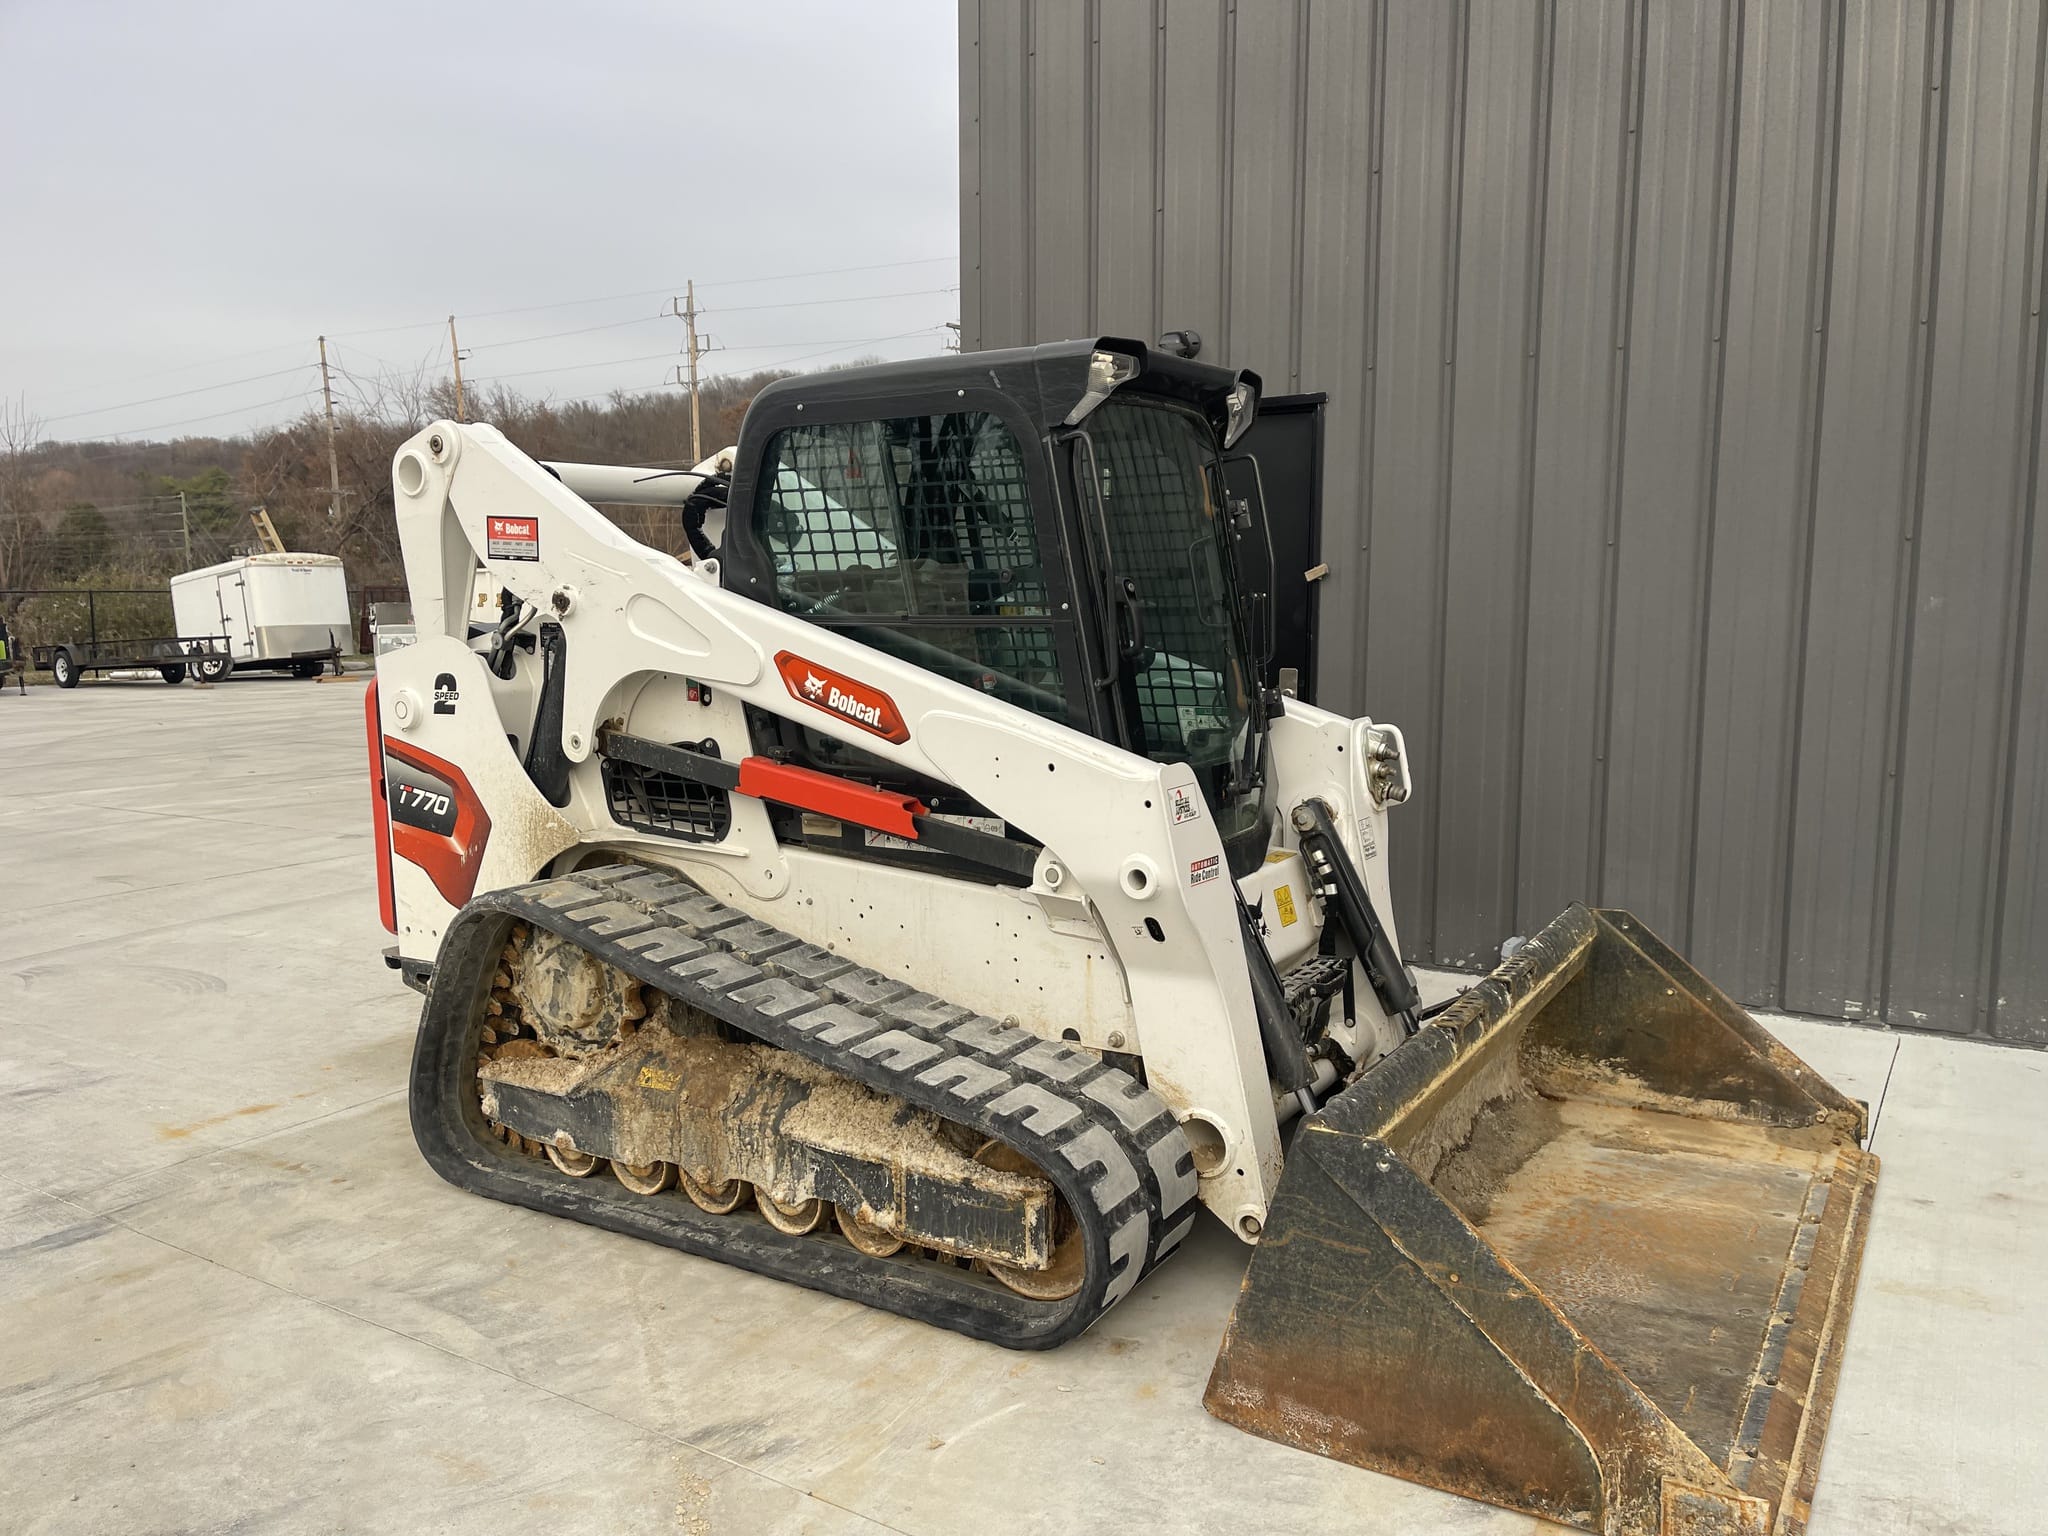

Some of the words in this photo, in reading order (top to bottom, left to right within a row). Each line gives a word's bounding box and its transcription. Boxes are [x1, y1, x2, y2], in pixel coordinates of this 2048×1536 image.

[505, 523, 530, 535] Bobcat
[434, 673, 457, 714] 2
[434, 692, 459, 700] SPEED
[828, 687, 882, 728] Bobcat
[400, 784, 450, 815] T770
[1191, 872, 1201, 884] Ride
[1202, 866, 1220, 881] Control
